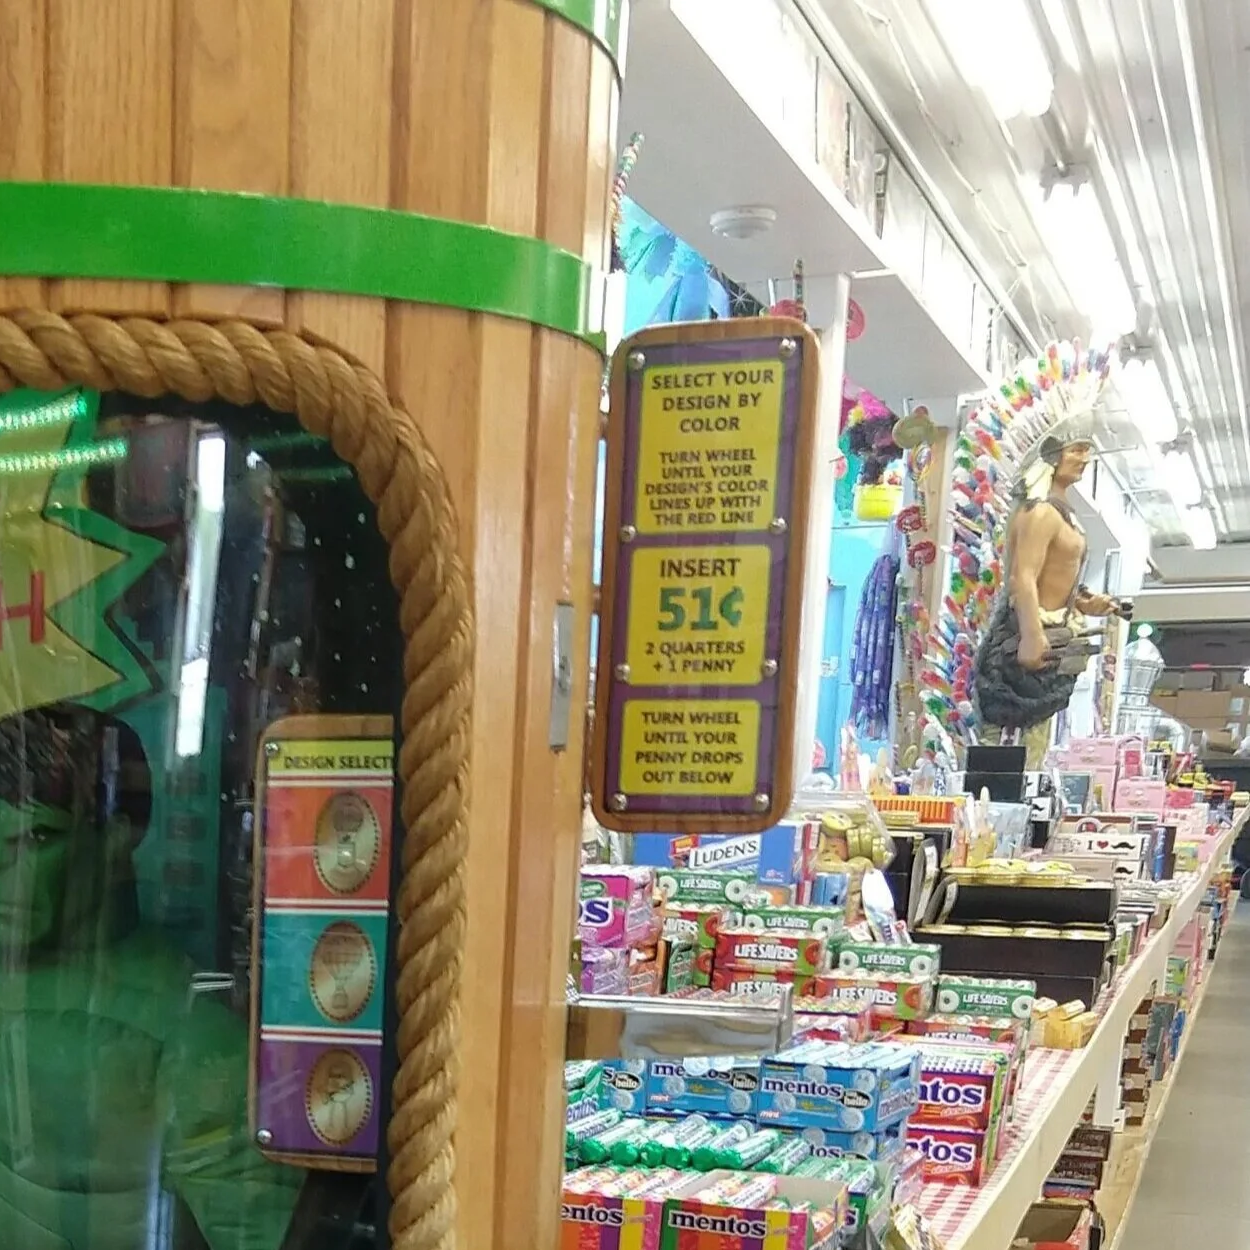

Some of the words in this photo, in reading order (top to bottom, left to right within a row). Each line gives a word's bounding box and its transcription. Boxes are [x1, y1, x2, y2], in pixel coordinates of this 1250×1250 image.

[652, 373, 715, 390] SELECT
[723, 369, 774, 386] YOUR
[662, 395, 730, 411] DESIGN
[738, 392, 762, 408] BY
[680, 417, 740, 433] COLOR
[658, 451, 700, 464] TURN
[706, 448, 756, 462] WHEEL
[662, 466, 705, 479] UNTIL
[711, 464, 752, 478] YOUR
[645, 481, 712, 496] DESIGN'S
[718, 479, 768, 493] COLOR
[650, 498, 691, 510] LINES
[696, 497, 715, 509] UP
[721, 495, 761, 508] WITH
[654, 513, 684, 525] THE
[688, 512, 716, 524] RED
[721, 511, 754, 524] LINE
[660, 558, 741, 578] INSERT
[658, 585, 744, 631] 51¢
[645, 642, 655, 655] 2
[659, 640, 745, 658] QUARTERS
[654, 662, 662, 672] +
[669, 661, 677, 673] 1
[682, 659, 736, 673] PENNY
[642, 711, 684, 725] TURN
[690, 711, 741, 725] WHEEL
[644, 732, 688, 744] UNTIL
[694, 732, 737, 745] YOUR
[284, 756, 335, 769] DESIGN
[635, 751, 687, 764] PENNY
[691, 751, 744, 764] DROPS
[642, 771, 674, 784] OUT
[679, 771, 734, 784] BELOW
[694, 840, 757, 867] LUDEN'S
[653, 1063, 731, 1079] meos
[764, 1079, 841, 1098] mentos
[918, 1080, 982, 1105] ntos
[561, 1204, 623, 1224] entos
[670, 1211, 766, 1236] mentos
